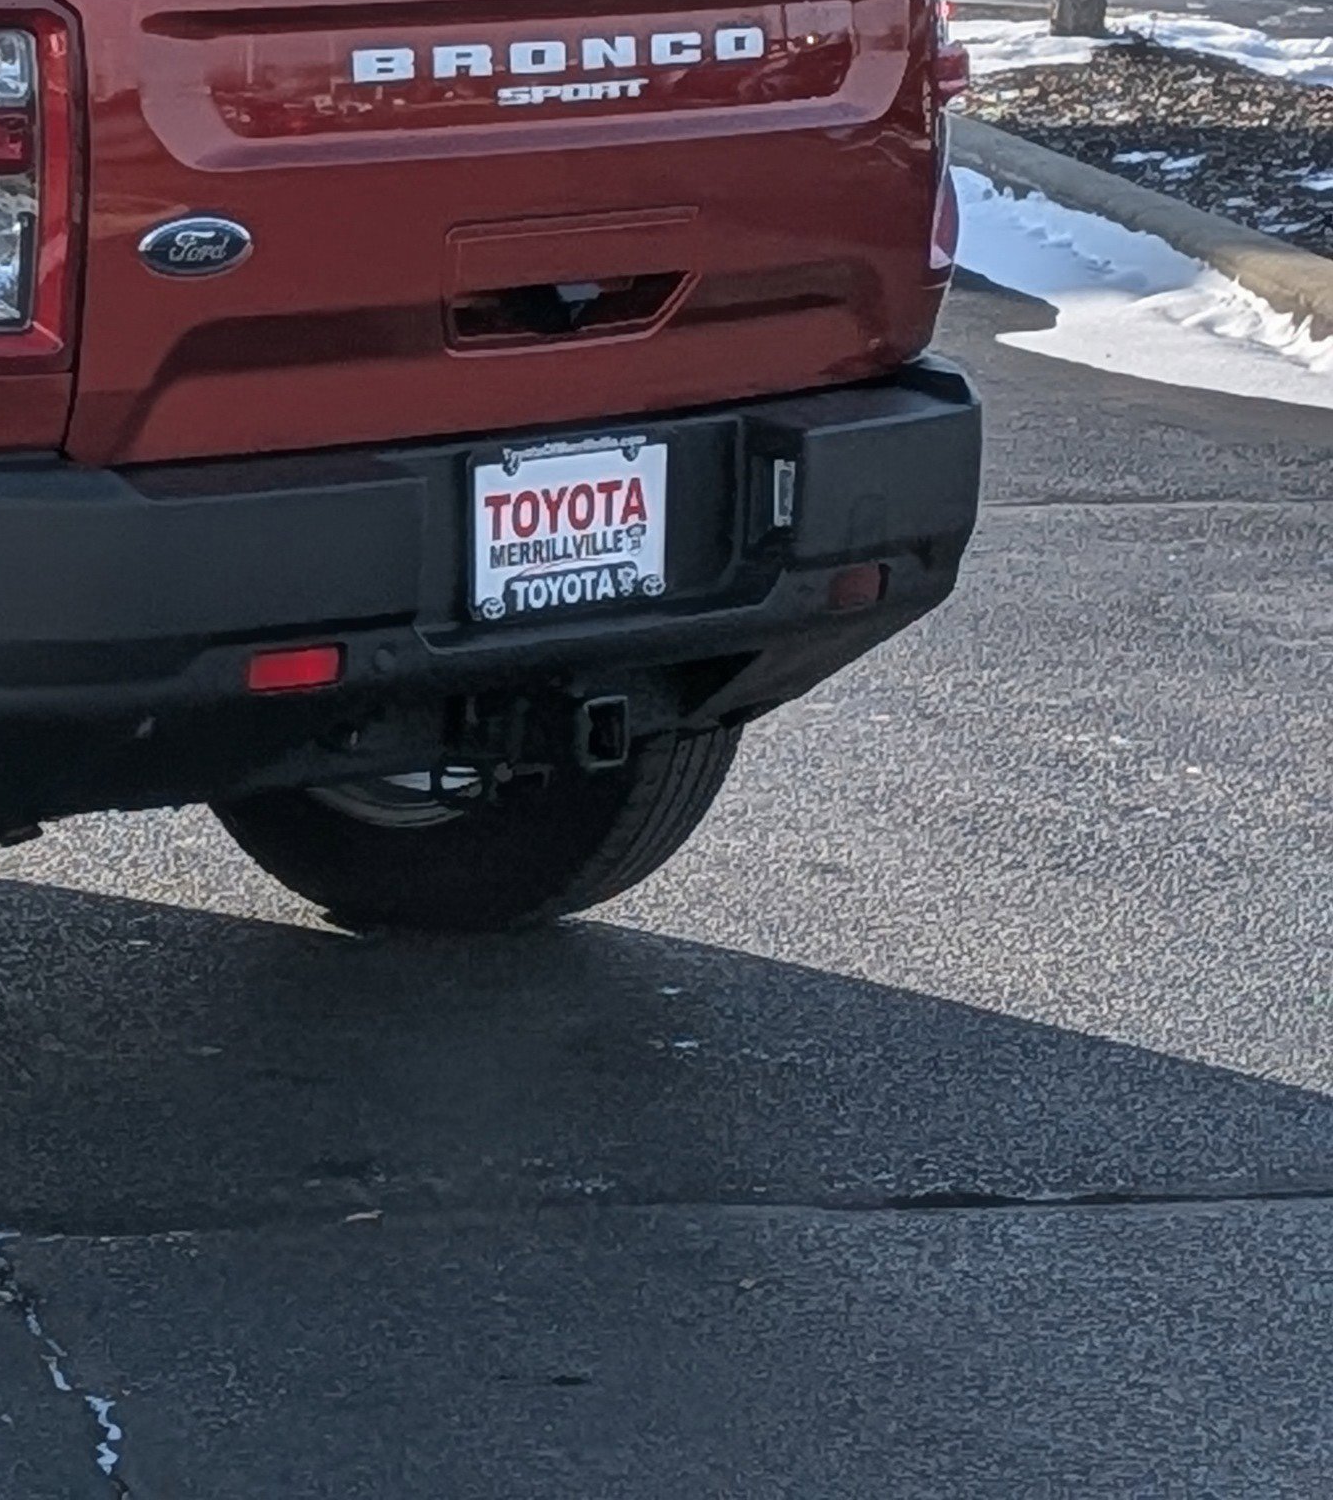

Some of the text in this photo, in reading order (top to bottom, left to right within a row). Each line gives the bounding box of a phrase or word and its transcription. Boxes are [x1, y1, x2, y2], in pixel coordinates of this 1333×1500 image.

[353, 27, 764, 83] BRONCO
[498, 78, 649, 106] SPORT
[169, 230, 231, 261] Ford
[485, 477, 647, 541] TOYOTA
[489, 529, 624, 569] MERRILLVILLE
[511, 567, 616, 612] TOYOTA
